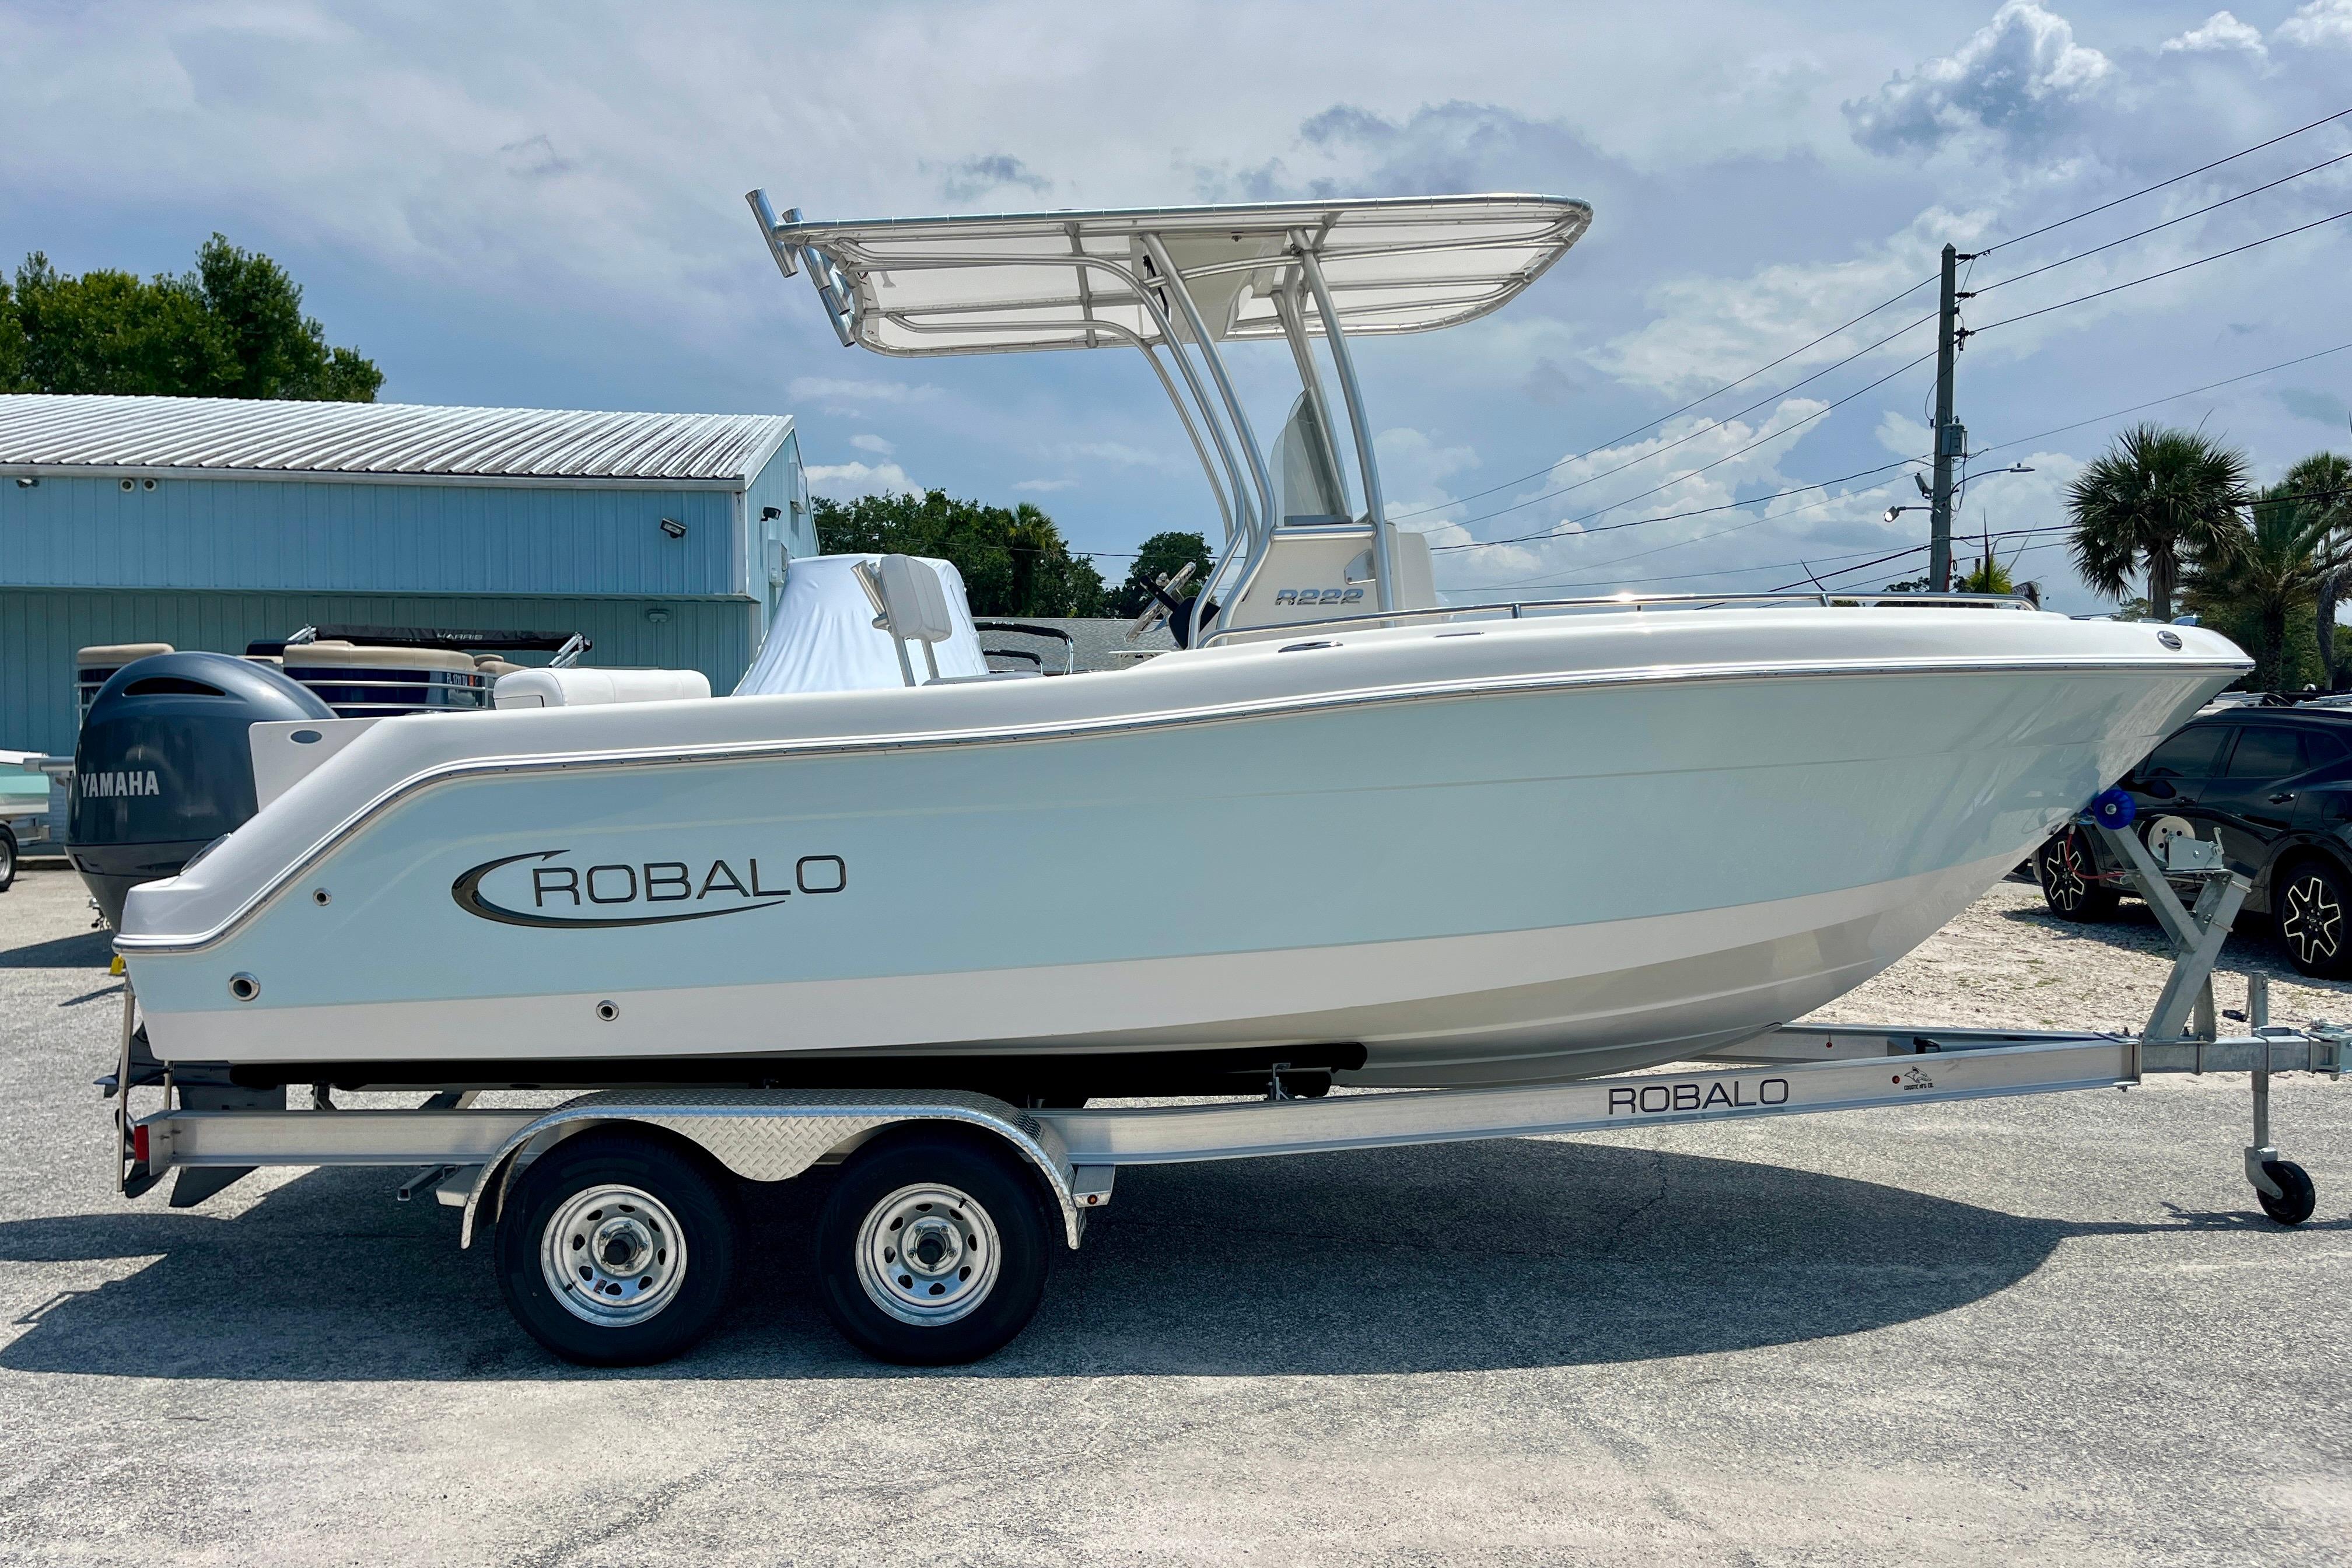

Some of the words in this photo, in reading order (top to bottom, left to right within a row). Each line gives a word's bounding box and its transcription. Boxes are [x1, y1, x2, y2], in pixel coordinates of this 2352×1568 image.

[1275, 589, 1364, 606] R222
[447, 673, 453, 684] FL
[80, 771, 160, 797] YAMAHA
[533, 855, 846, 907] ROBALO
[1608, 1079, 1789, 1115] ROBALO
